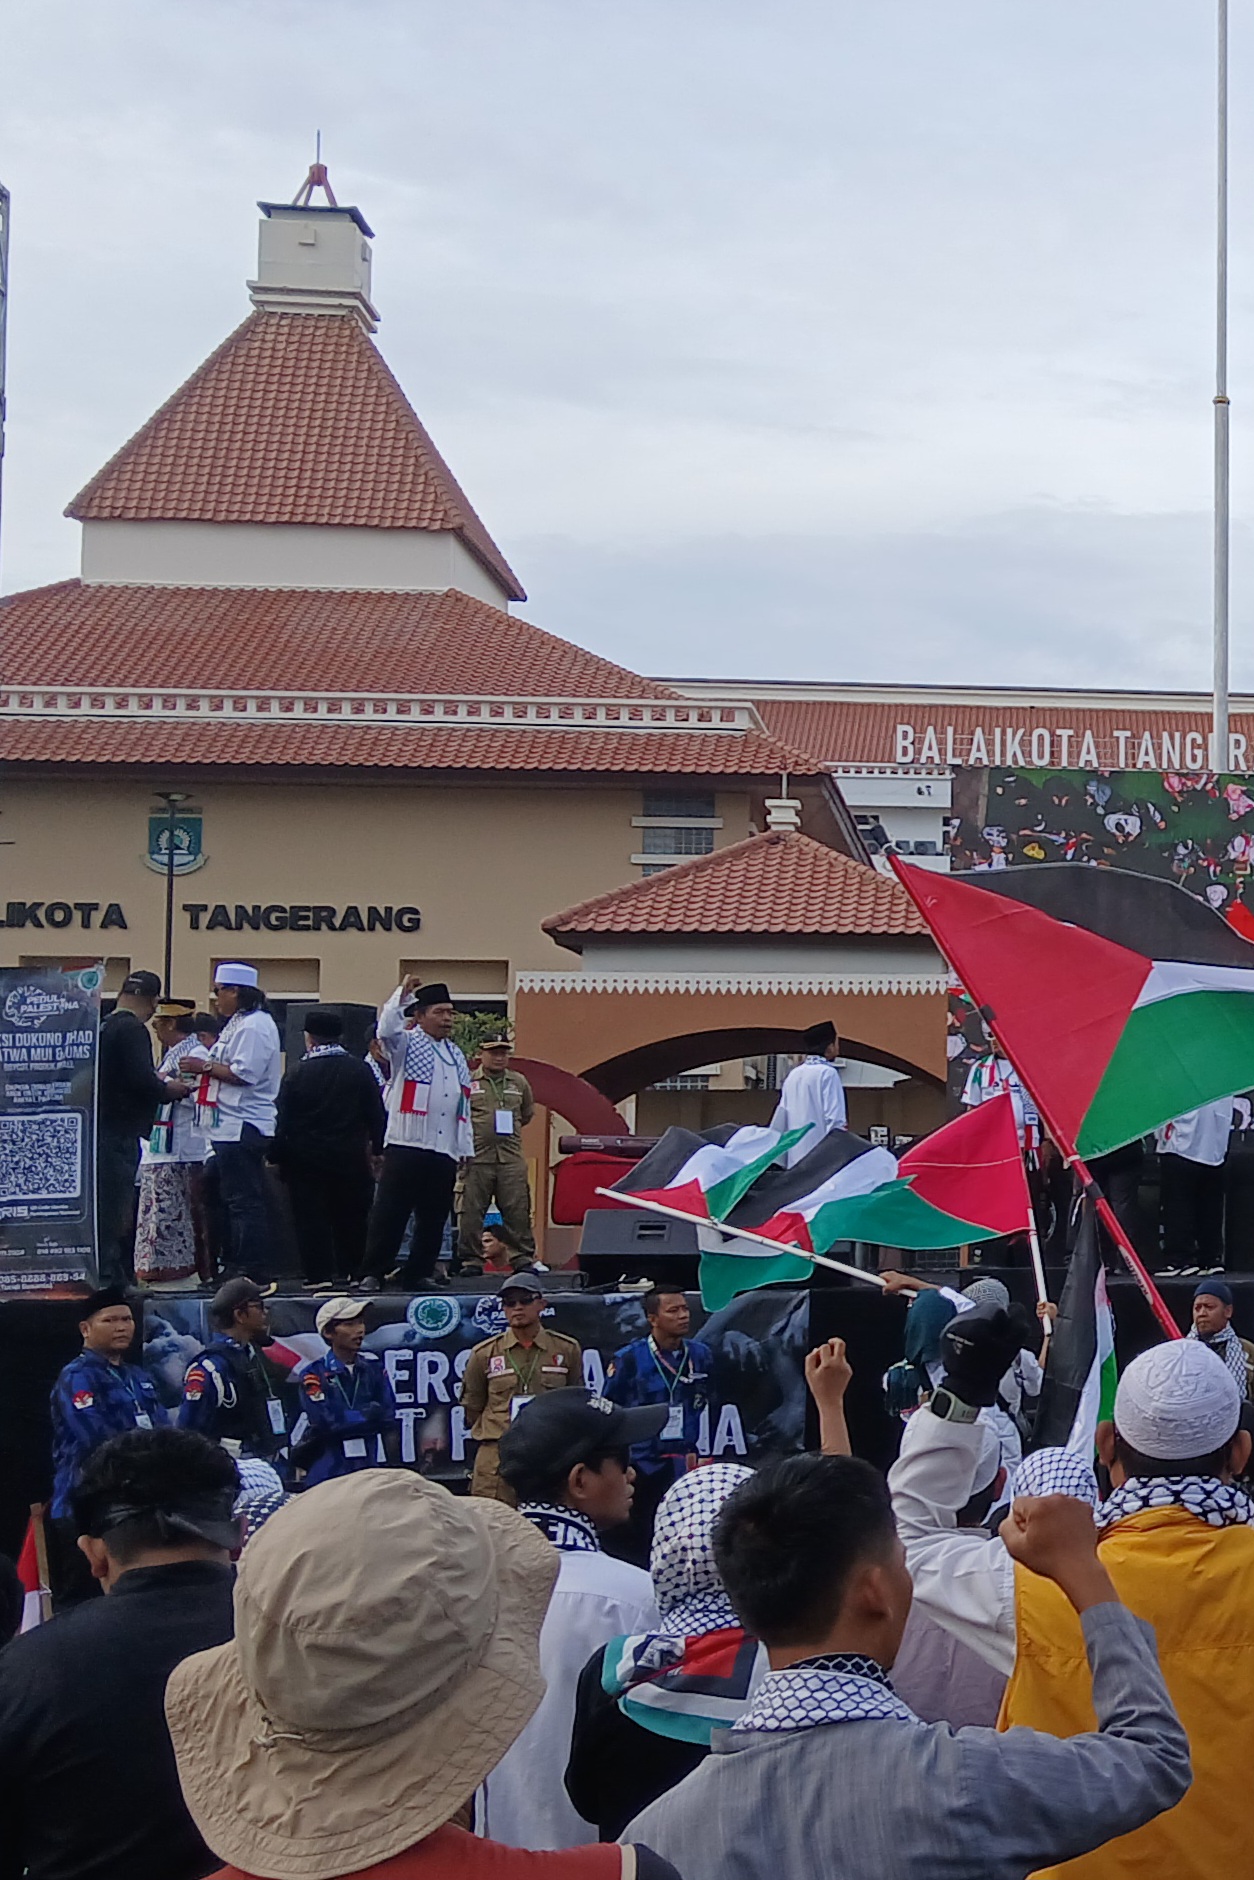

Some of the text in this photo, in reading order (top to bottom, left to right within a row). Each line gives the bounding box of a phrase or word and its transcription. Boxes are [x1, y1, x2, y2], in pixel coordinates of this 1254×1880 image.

[896, 724, 1099, 768] BALAIKOTA
[0, 901, 422, 933] IKOTA TANGERANG
[0, 1033, 13, 1047] SI
[30, 1046, 53, 1061] MUI
[0, 1205, 28, 1219] RIS
